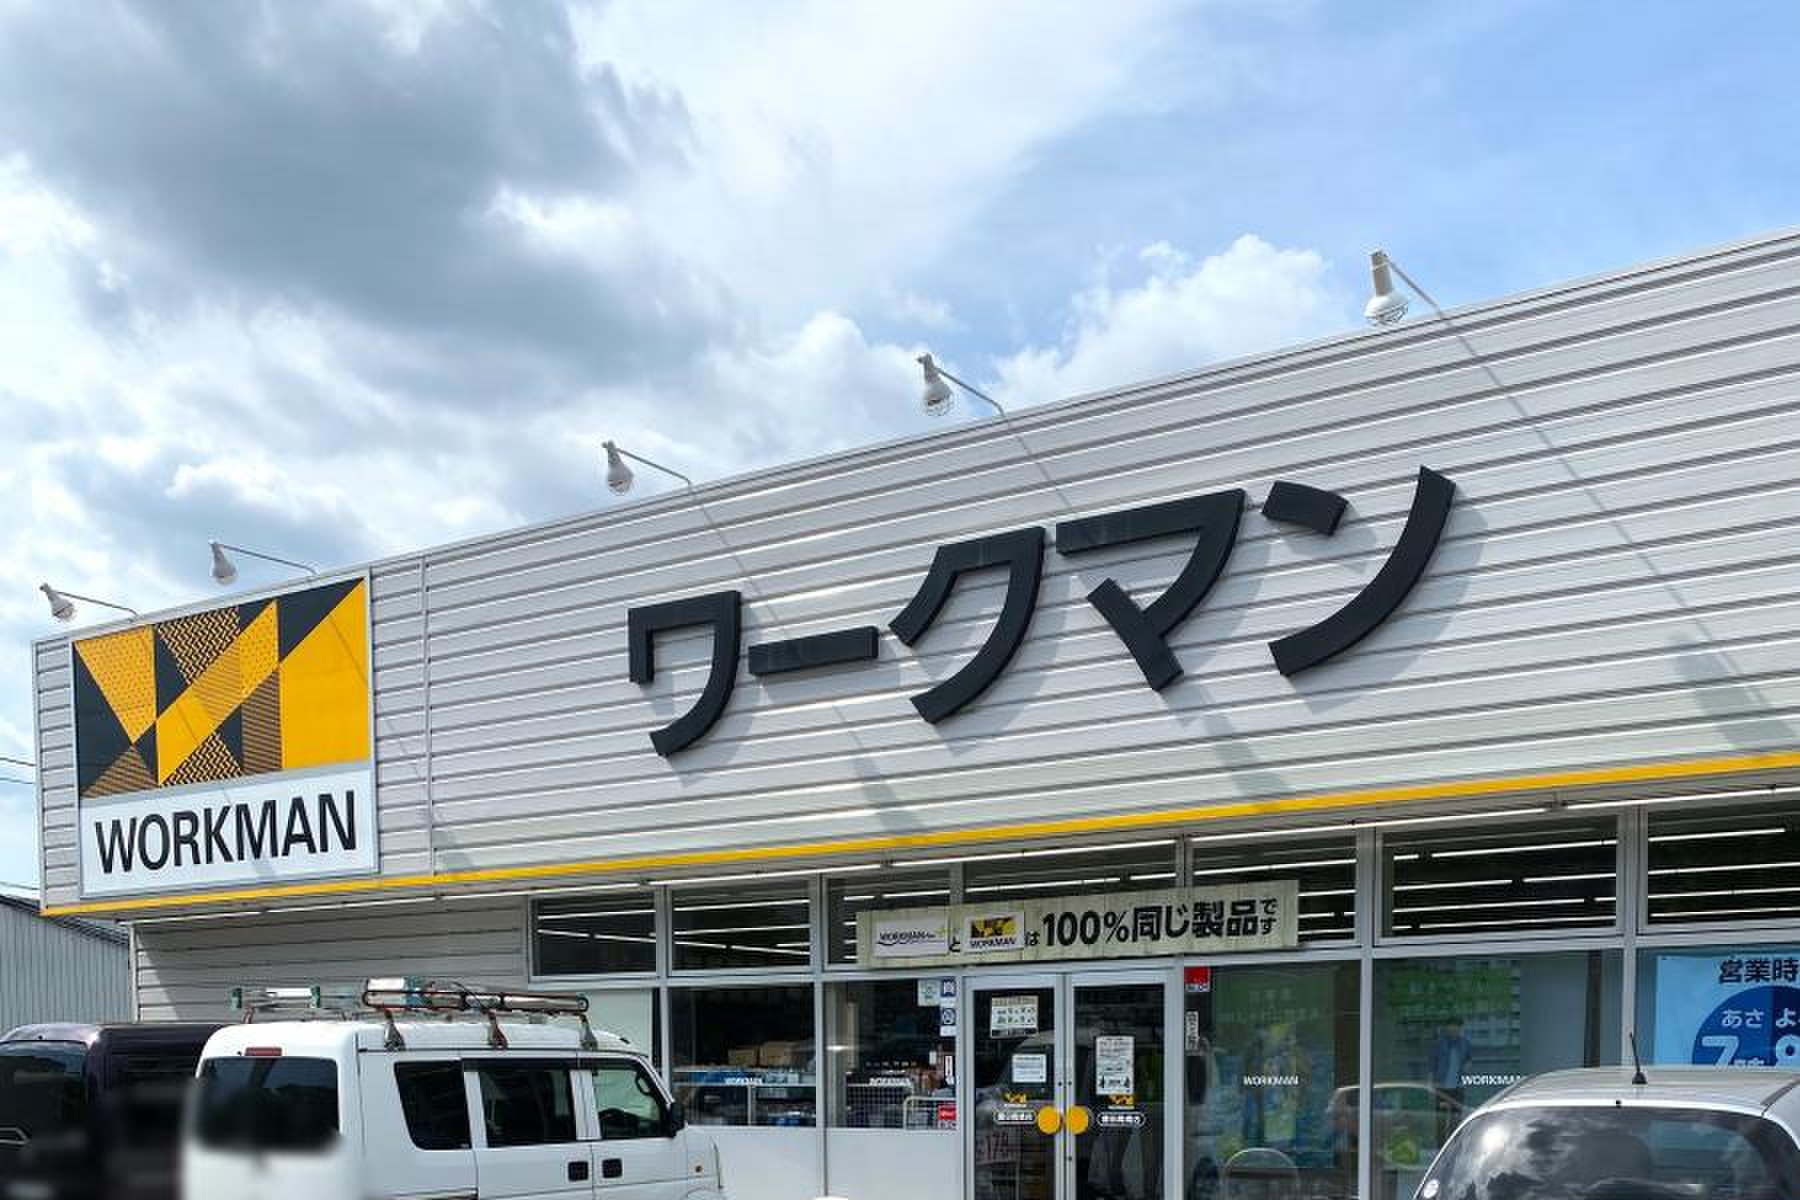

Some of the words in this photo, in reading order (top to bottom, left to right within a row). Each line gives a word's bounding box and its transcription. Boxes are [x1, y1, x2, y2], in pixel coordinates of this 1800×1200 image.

[627, 465, 1456, 758] ワークマン
[95, 790, 357, 874] WORKMAN
[1719, 957, 1799, 984] 営業時
[1721, 1009, 1764, 1029] あさ
[1776, 1008, 1800, 1028] よ
[1243, 1075, 1299, 1087] WORKMAN
